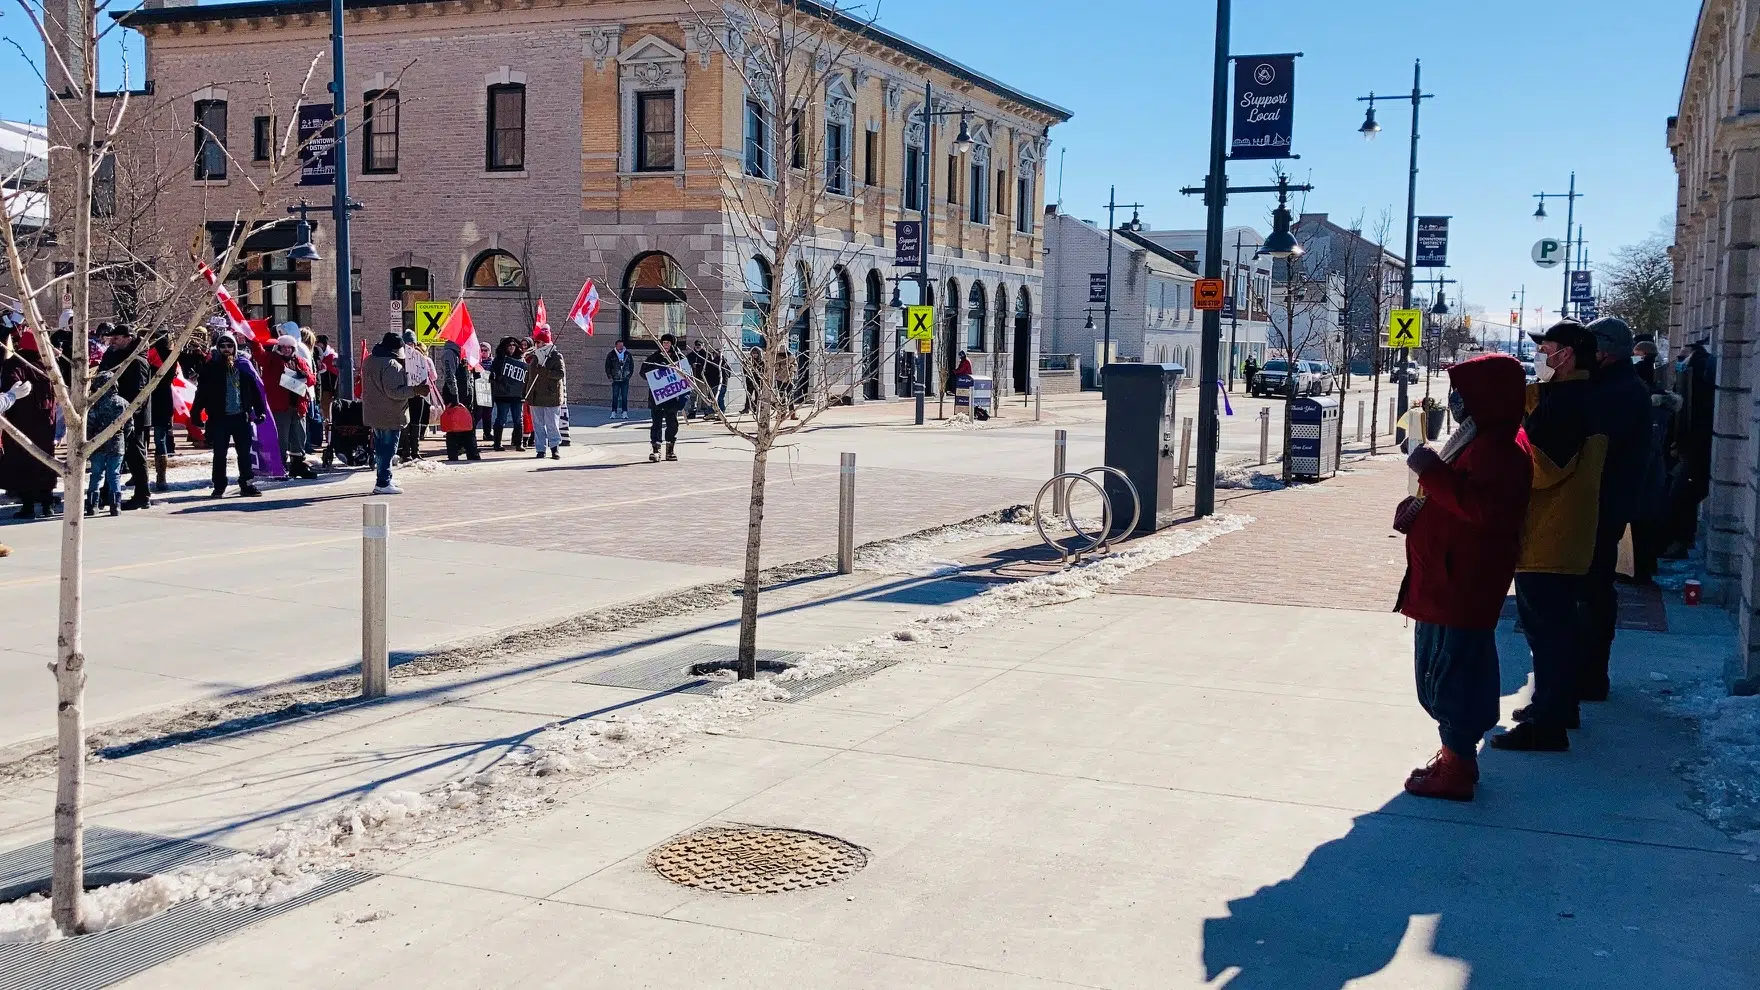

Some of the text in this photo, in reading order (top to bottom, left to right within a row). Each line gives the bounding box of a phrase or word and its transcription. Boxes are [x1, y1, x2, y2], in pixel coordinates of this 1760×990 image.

[1240, 92, 1288, 108] Support
[1247, 108, 1281, 123] Local
[1541, 241, 1558, 259] P
[423, 311, 444, 336] X
[913, 313, 928, 332] X
[1395, 317, 1415, 339] X
[666, 374, 677, 383] IN
